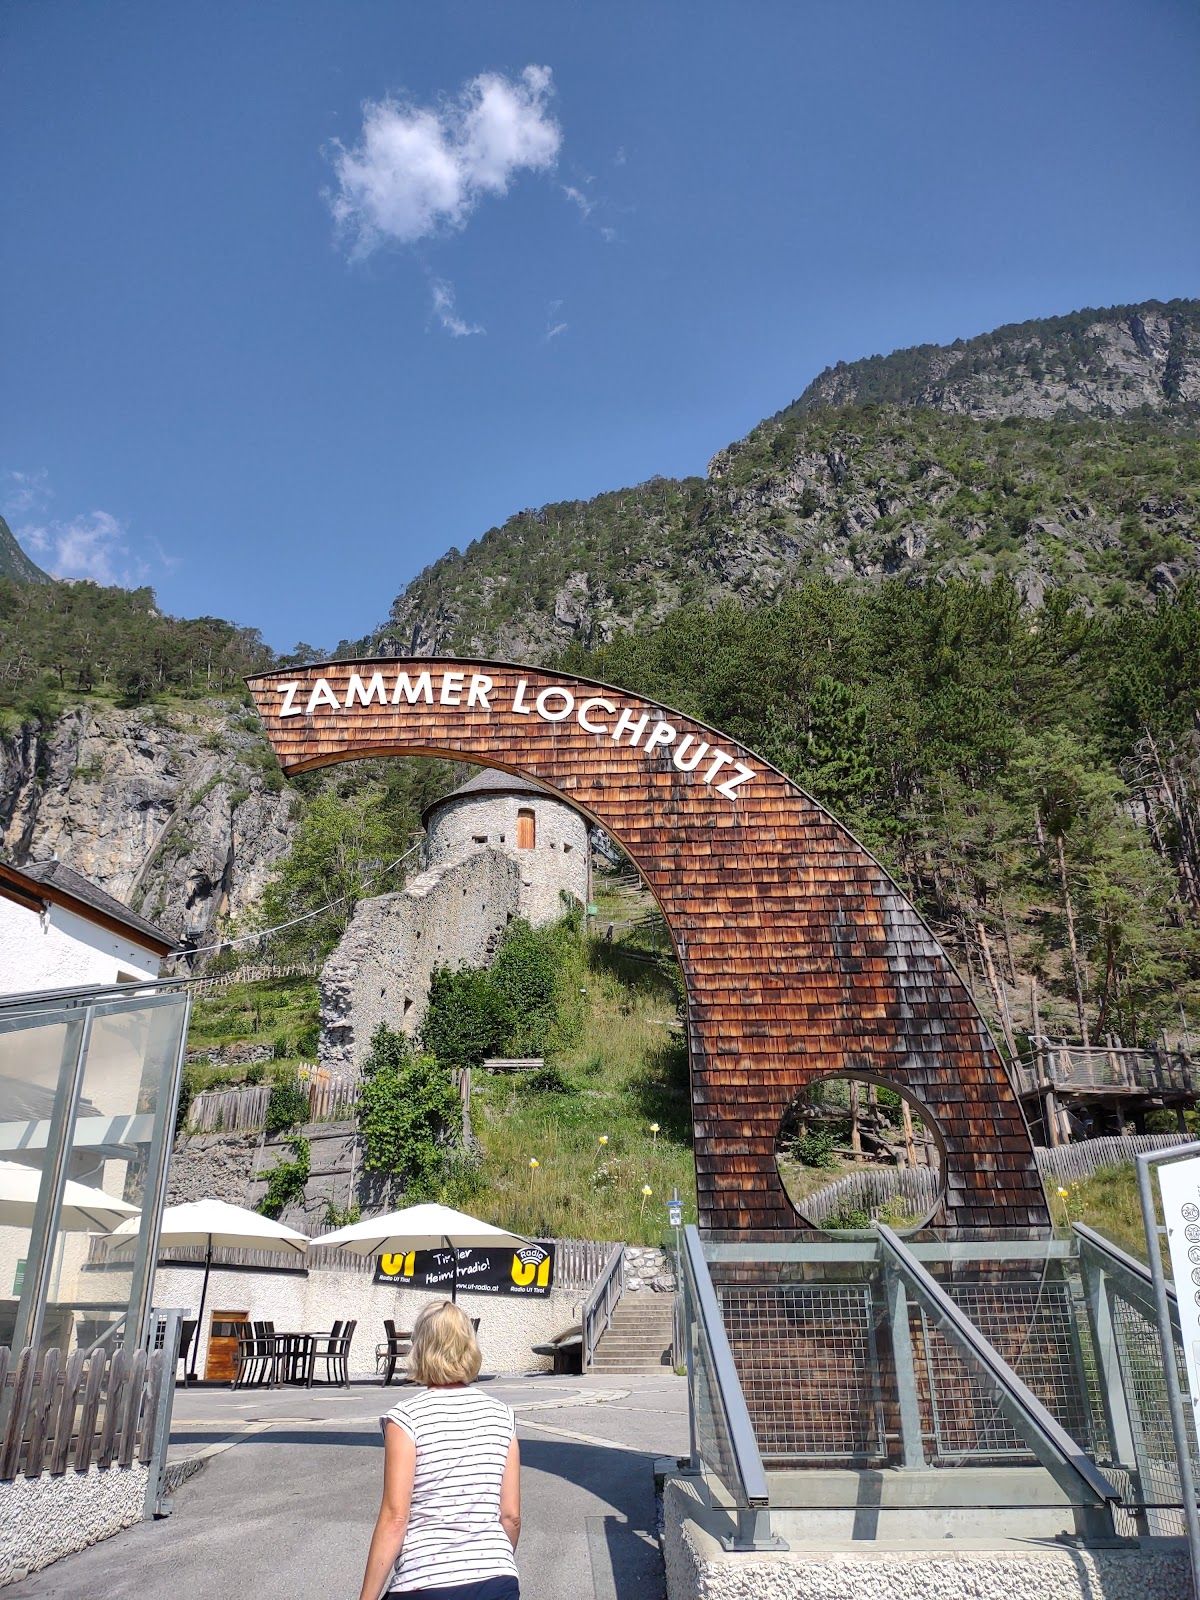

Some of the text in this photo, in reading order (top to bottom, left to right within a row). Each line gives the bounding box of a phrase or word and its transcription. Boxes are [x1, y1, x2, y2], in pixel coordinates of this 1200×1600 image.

[277, 671, 758, 801] ZAMMER LOCHPUTZ
[511, 1253, 551, 1287] U1
[520, 1250, 544, 1260] Radio
